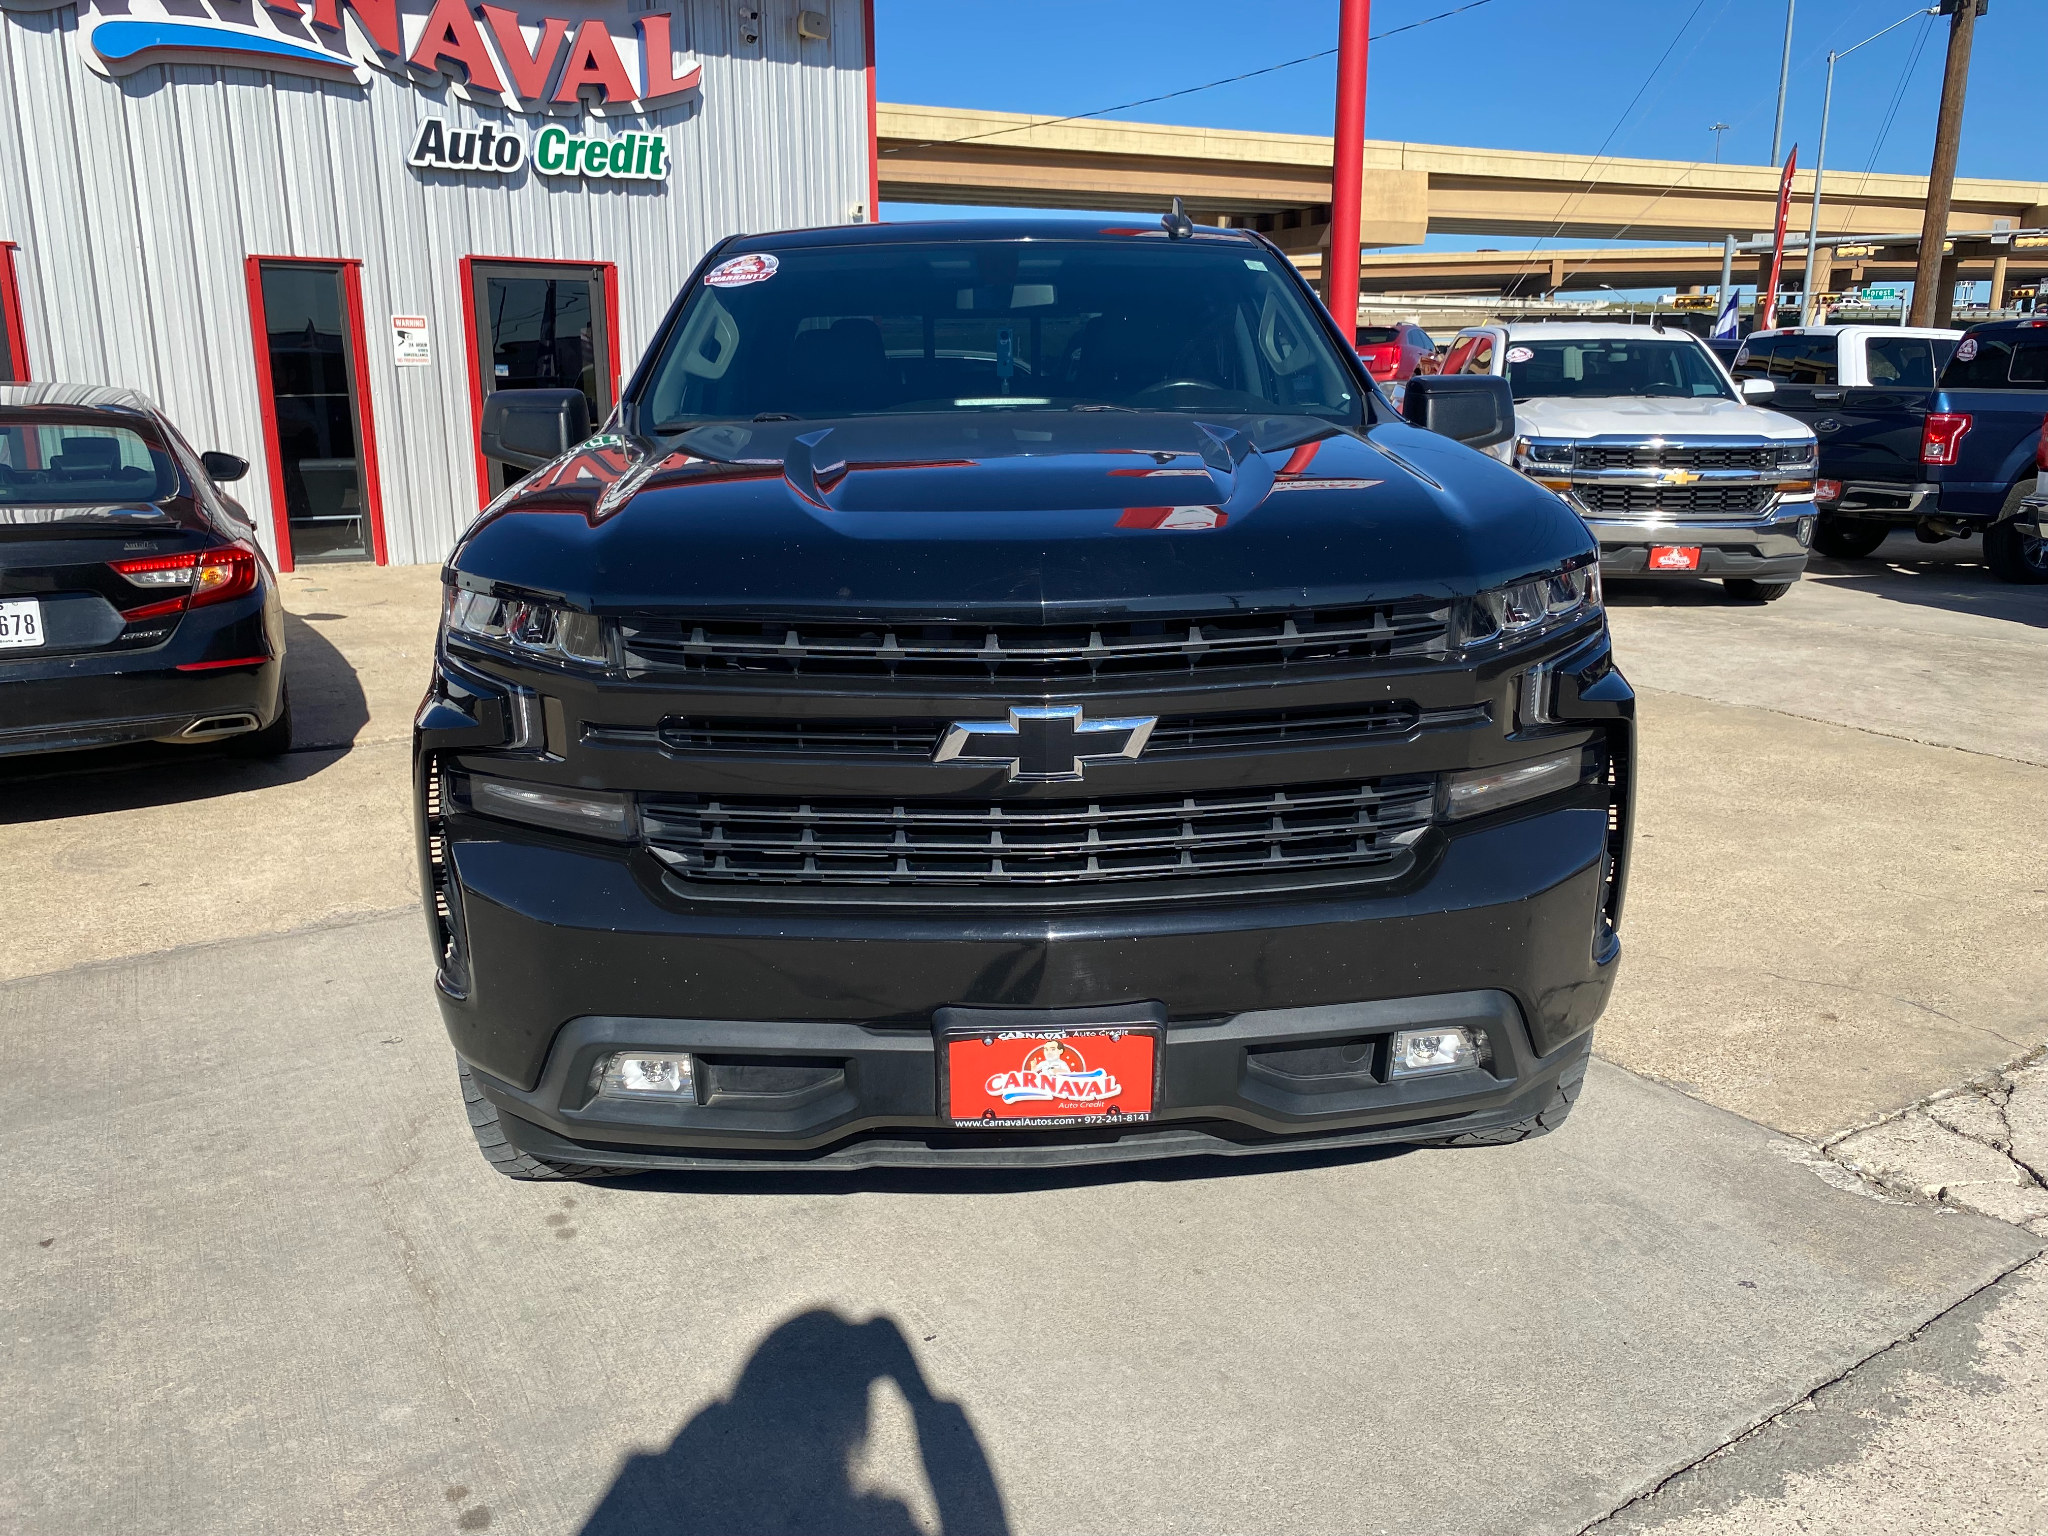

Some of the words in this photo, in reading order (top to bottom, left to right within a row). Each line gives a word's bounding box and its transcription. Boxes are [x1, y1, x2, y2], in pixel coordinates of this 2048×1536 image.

[413, 119, 521, 168] Auto
[538, 128, 666, 175] Credit
[709, 273, 766, 283] WARRANTY
[1866, 289, 1891, 297] Forest
[395, 318, 424, 328] WARNING
[997, 1030, 1070, 1041] CARNAVAL
[1072, 1030, 1097, 1038] Auto
[1098, 1029, 1129, 1038] Credit
[986, 1070, 1120, 1099] CARNAVAL
[1080, 1101, 1106, 1109] Credit
[955, 1116, 1075, 1128] www.CarnavalAutos.com
[1084, 1113, 1150, 1124] 972-241-8141
